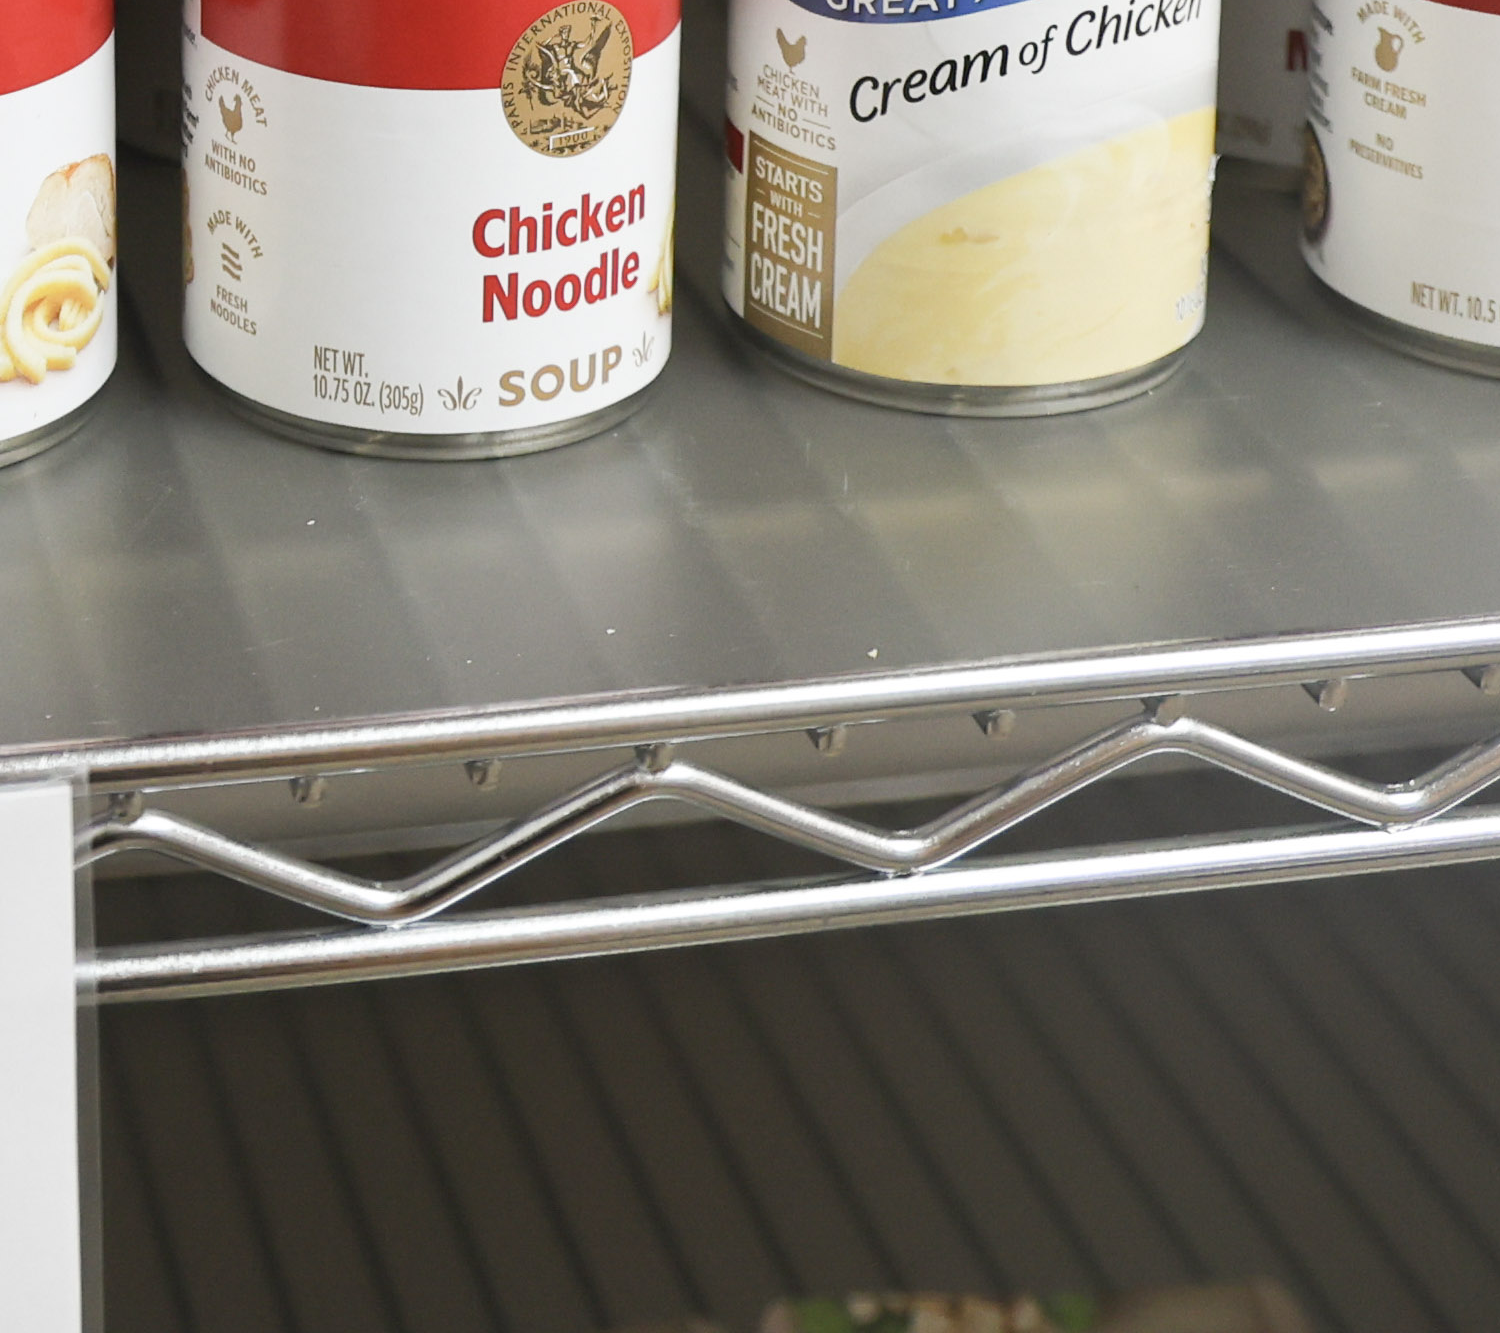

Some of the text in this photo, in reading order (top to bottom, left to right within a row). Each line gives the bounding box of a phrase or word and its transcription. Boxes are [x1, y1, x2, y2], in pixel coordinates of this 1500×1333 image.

[506, 1, 611, 71] INTERNATIONAL
[1357, 0, 1426, 44] MADE WITH
[763, 64, 820, 99] CHICKEN
[848, 39, 1010, 124] Cream
[1017, 24, 1055, 77] of
[1384, 82, 1427, 107] FRESH
[205, 67, 267, 128] CHICKEN MEAT
[502, 82, 523, 129] PARIS
[757, 75, 829, 118] MEAT WITH
[778, 105, 798, 123] NO
[1365, 92, 1407, 119] CREAM
[751, 104, 837, 151] ANTIBIOTICS
[204, 154, 267, 196] ANTIBIOTICS
[211, 139, 256, 173] WITH NO
[755, 155, 824, 203] STARTS
[471, 183, 646, 259] Chicken
[770, 191, 803, 218] WITH
[207, 209, 263, 259] MADE WITH
[752, 201, 824, 273] FRESH
[216, 284, 248, 314] FRESH
[481, 249, 641, 324] Noodle
[751, 252, 822, 329] CREAM
[1411, 281, 1436, 308] NET
[1467, 295, 1496, 324] 10.5
[210, 298, 257, 335] NOODLES
[313, 345, 369, 378] NET WT.
[499, 344, 622, 407] SOUP
[313, 374, 424, 416] 10.75 OZ. (305g)
